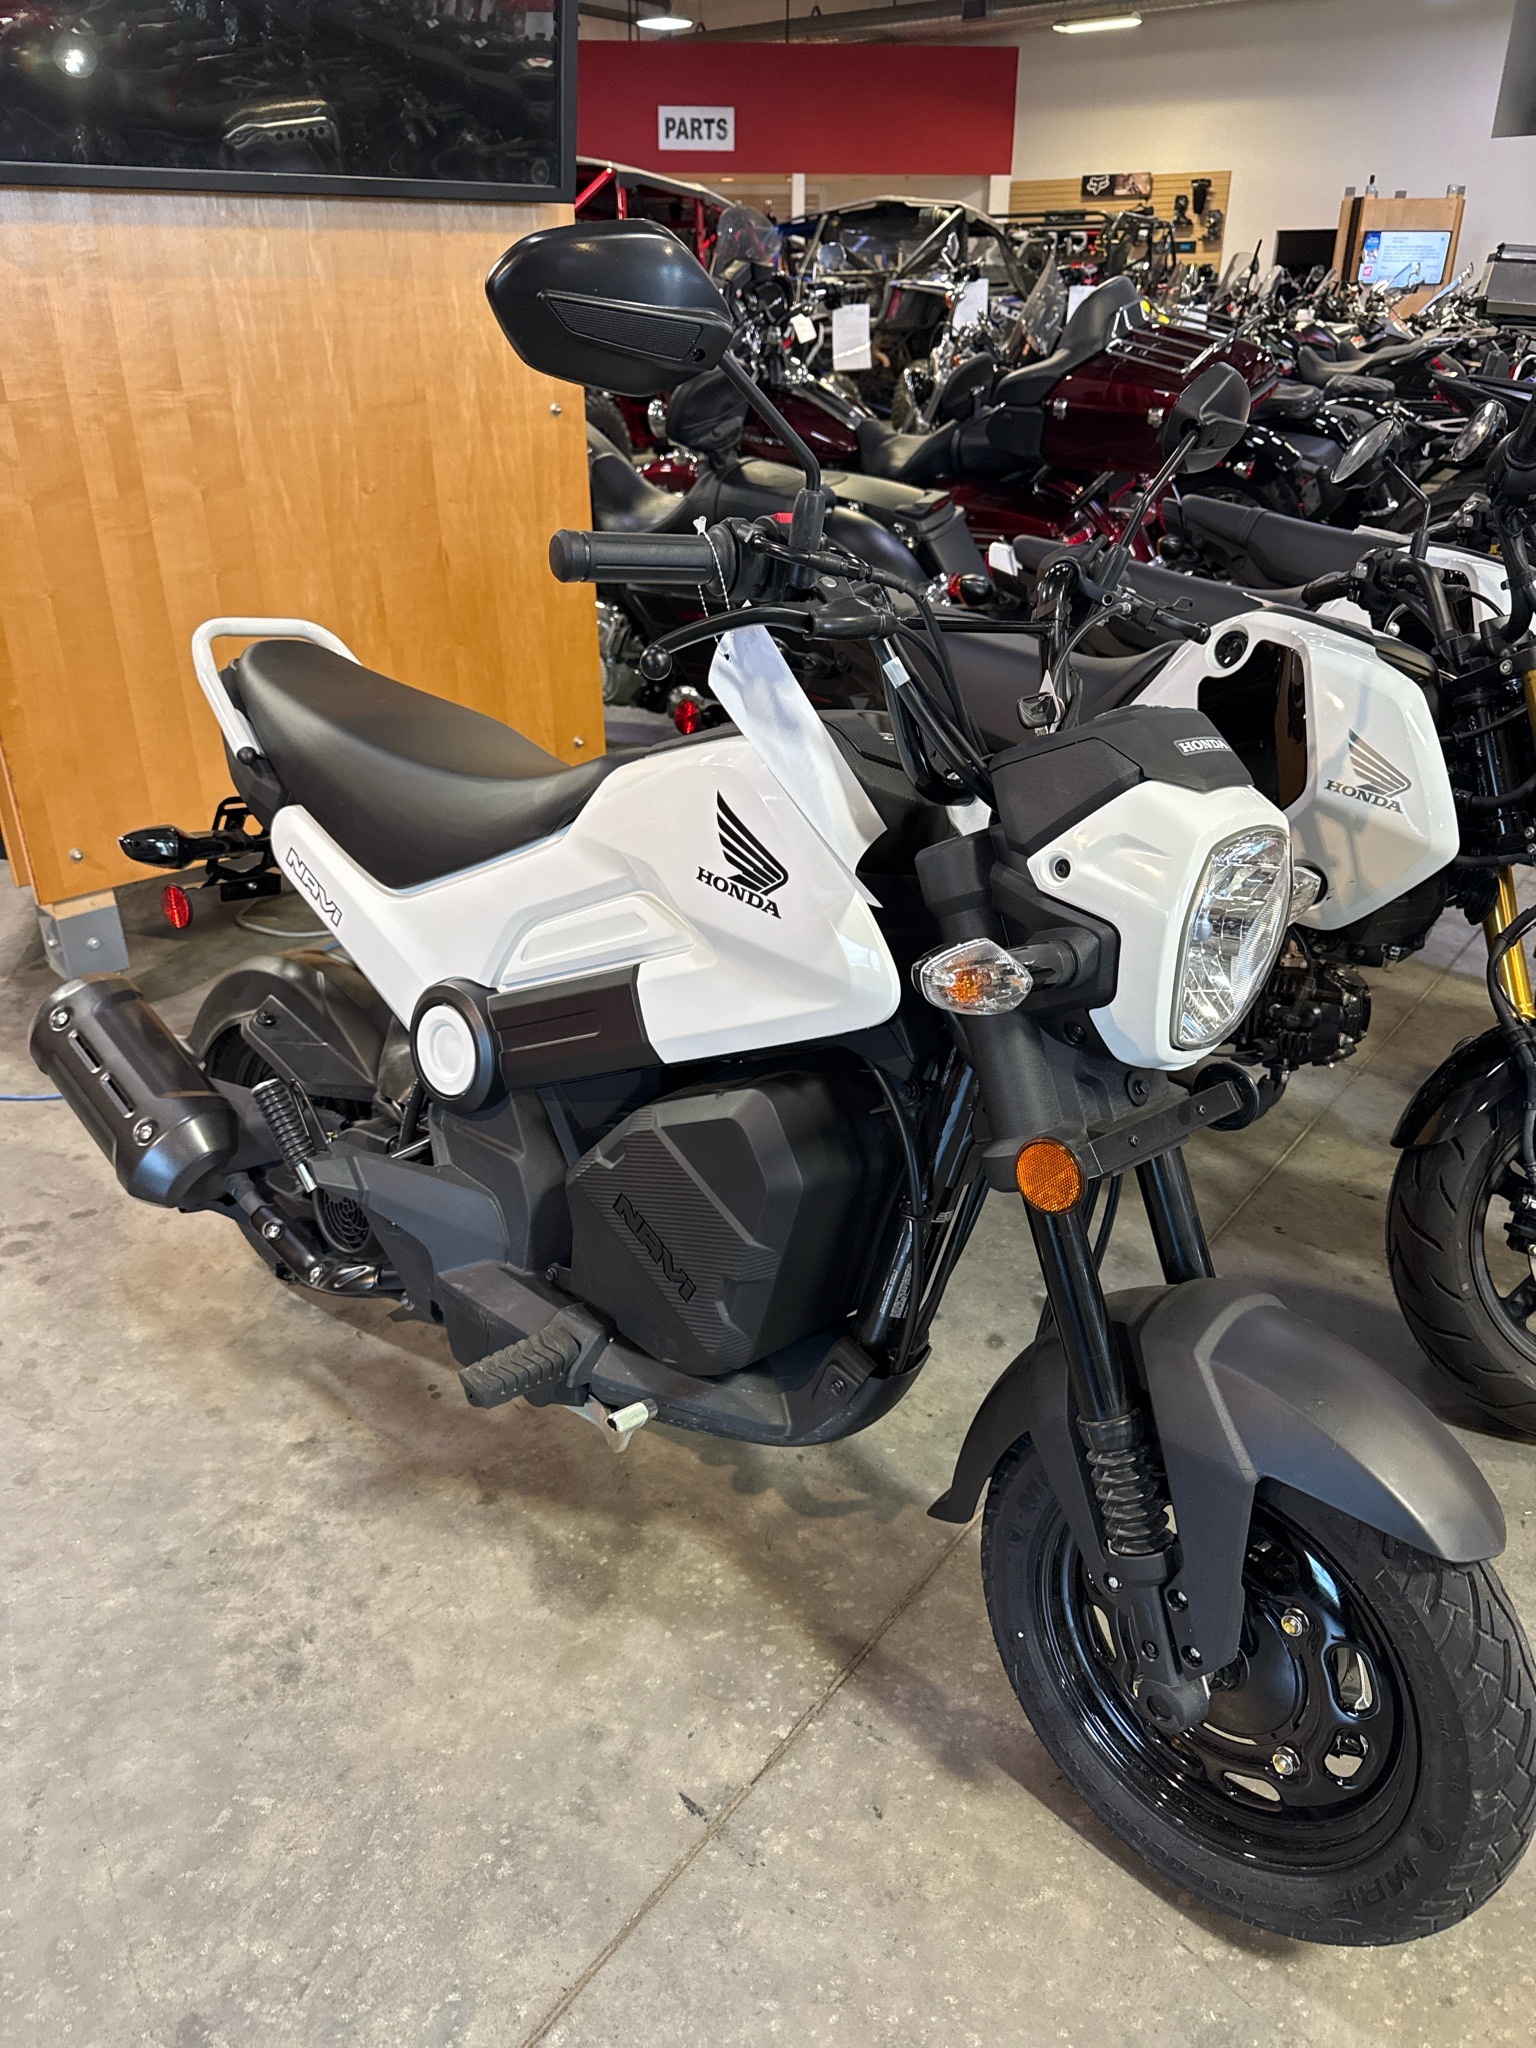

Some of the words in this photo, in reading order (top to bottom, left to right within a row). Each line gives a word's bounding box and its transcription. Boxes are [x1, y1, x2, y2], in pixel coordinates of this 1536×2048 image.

[665, 117, 728, 140] PARTS
[1178, 739, 1230, 753] HONDA
[1324, 779, 1403, 814] HONDA
[286, 846, 343, 928] NAVI
[696, 866, 782, 919] HONDA
[613, 1192, 697, 1303] NAVI
[1332, 1854, 1421, 1916] MRF
